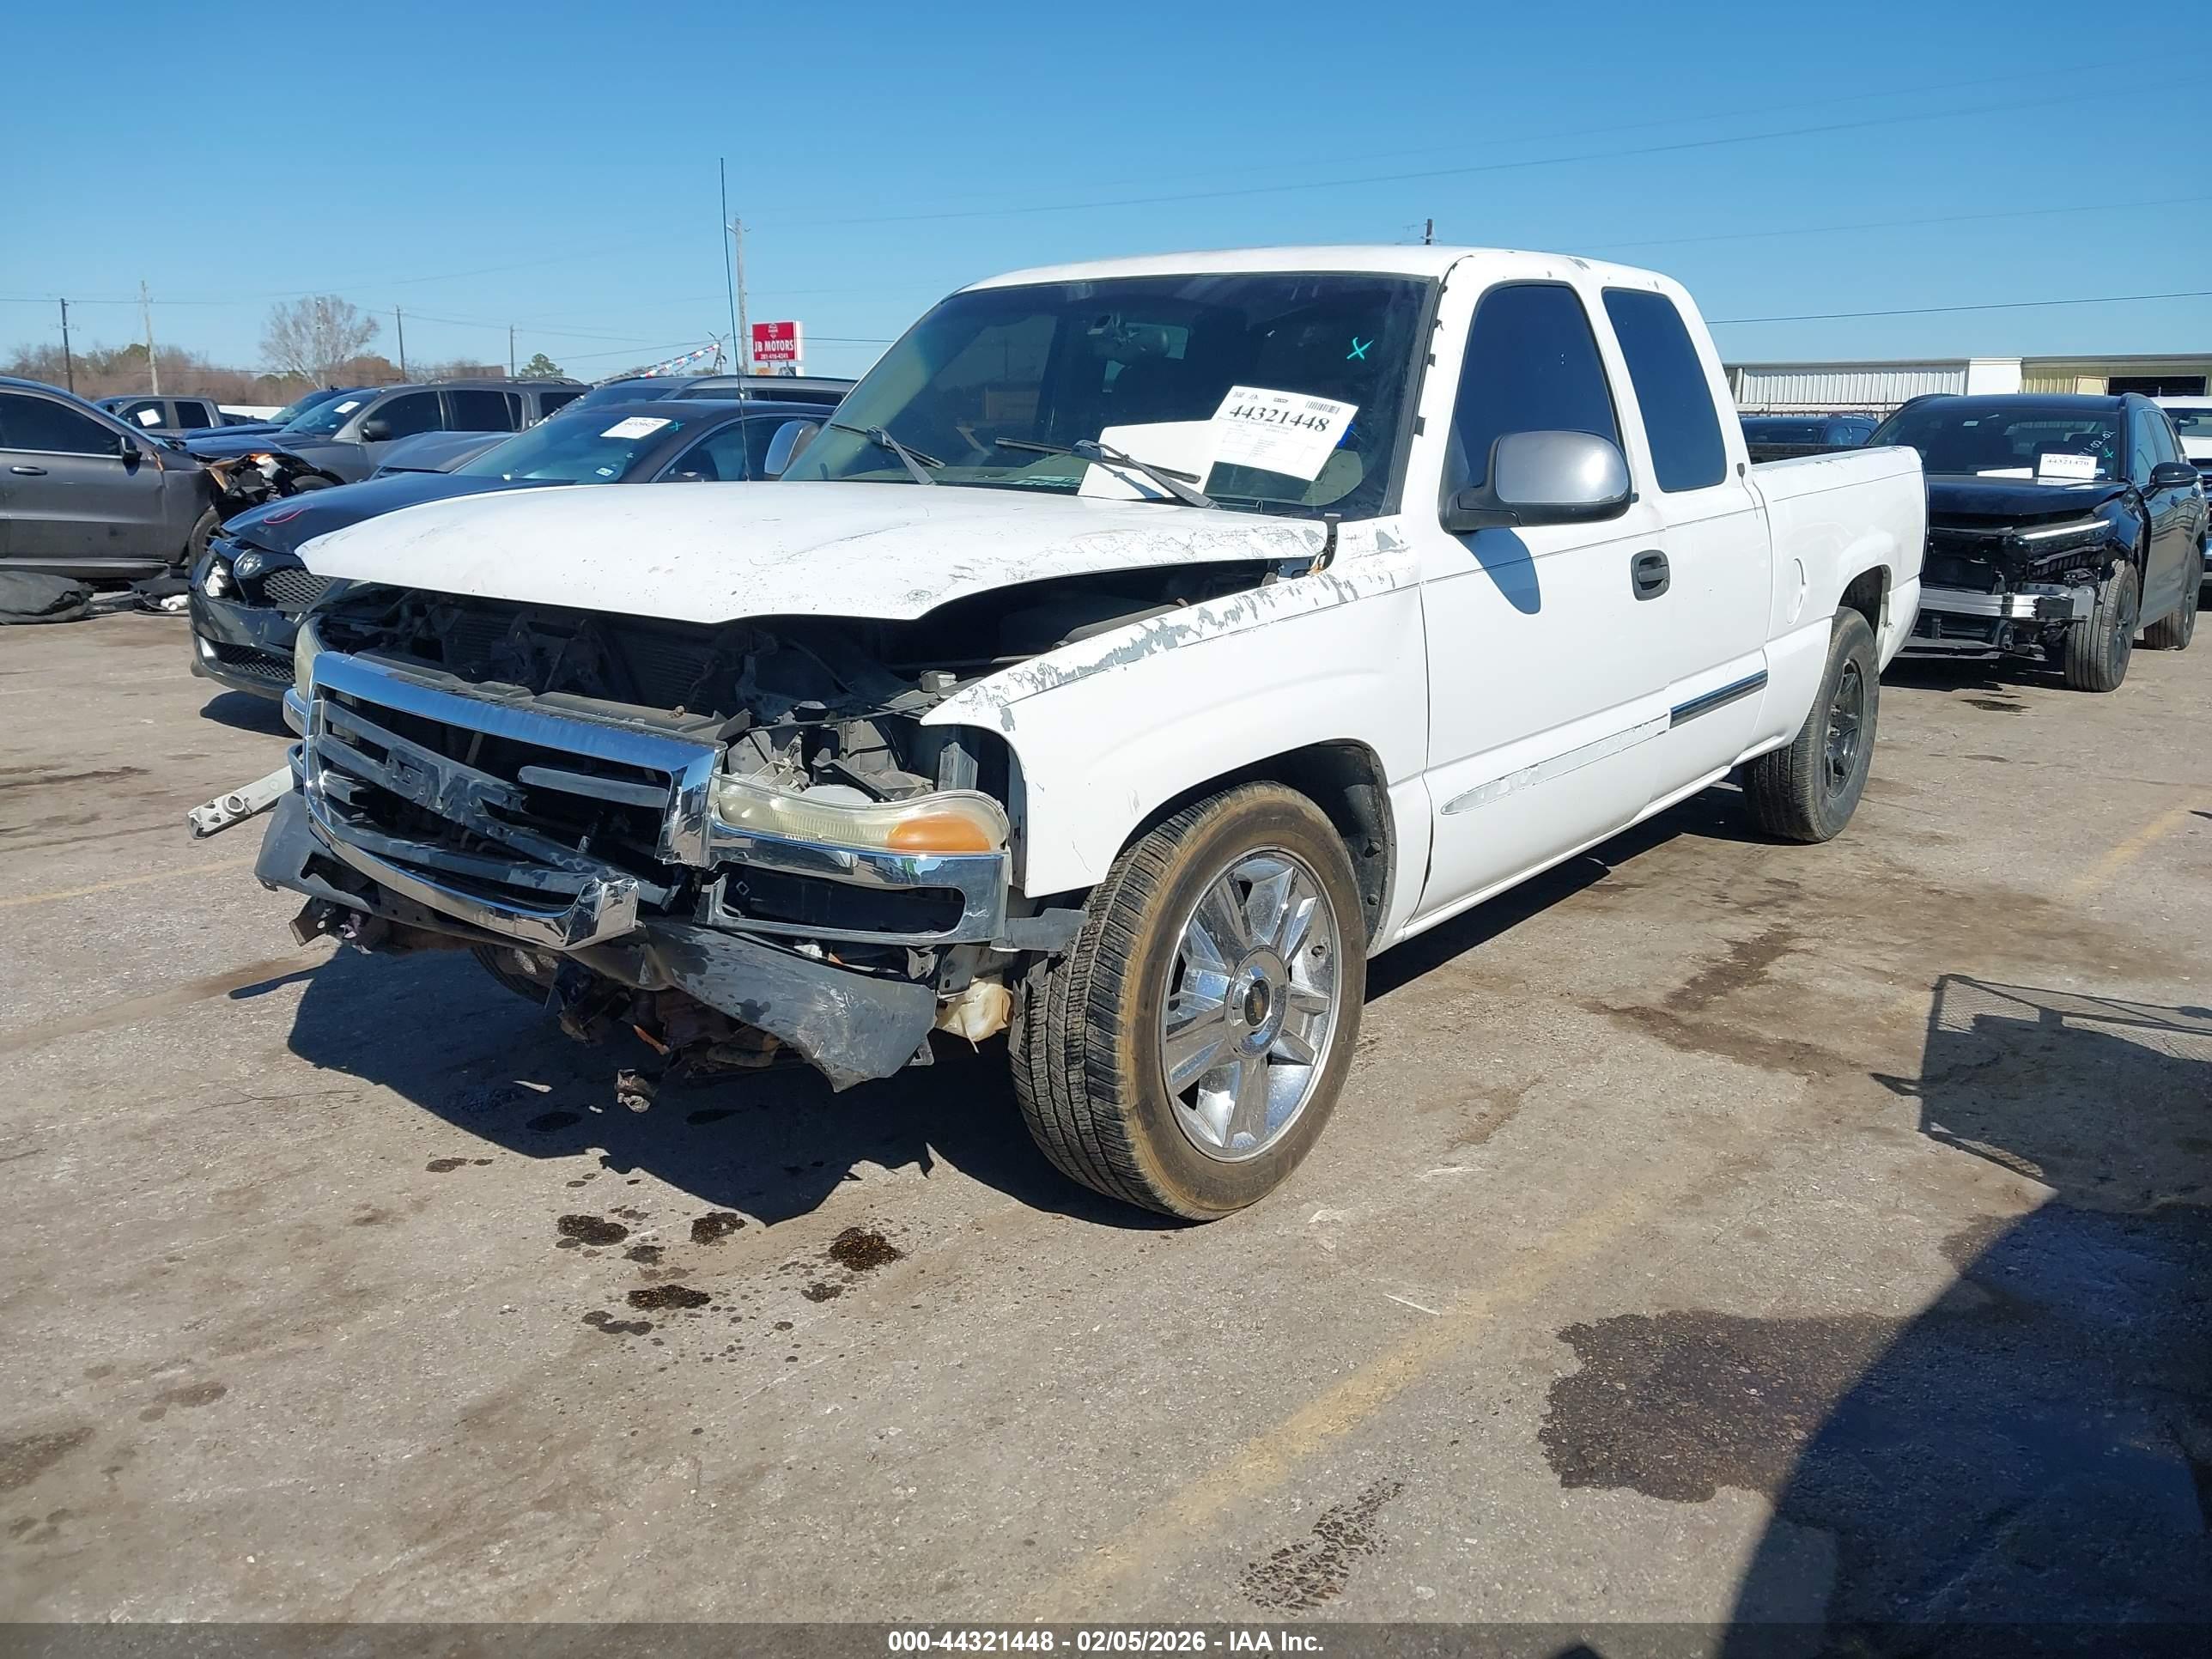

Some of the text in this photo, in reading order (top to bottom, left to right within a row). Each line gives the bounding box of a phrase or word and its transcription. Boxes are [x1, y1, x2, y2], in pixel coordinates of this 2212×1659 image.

[755, 340, 793, 352] JB MOTORS
[1230, 404, 1330, 433] 44321448
